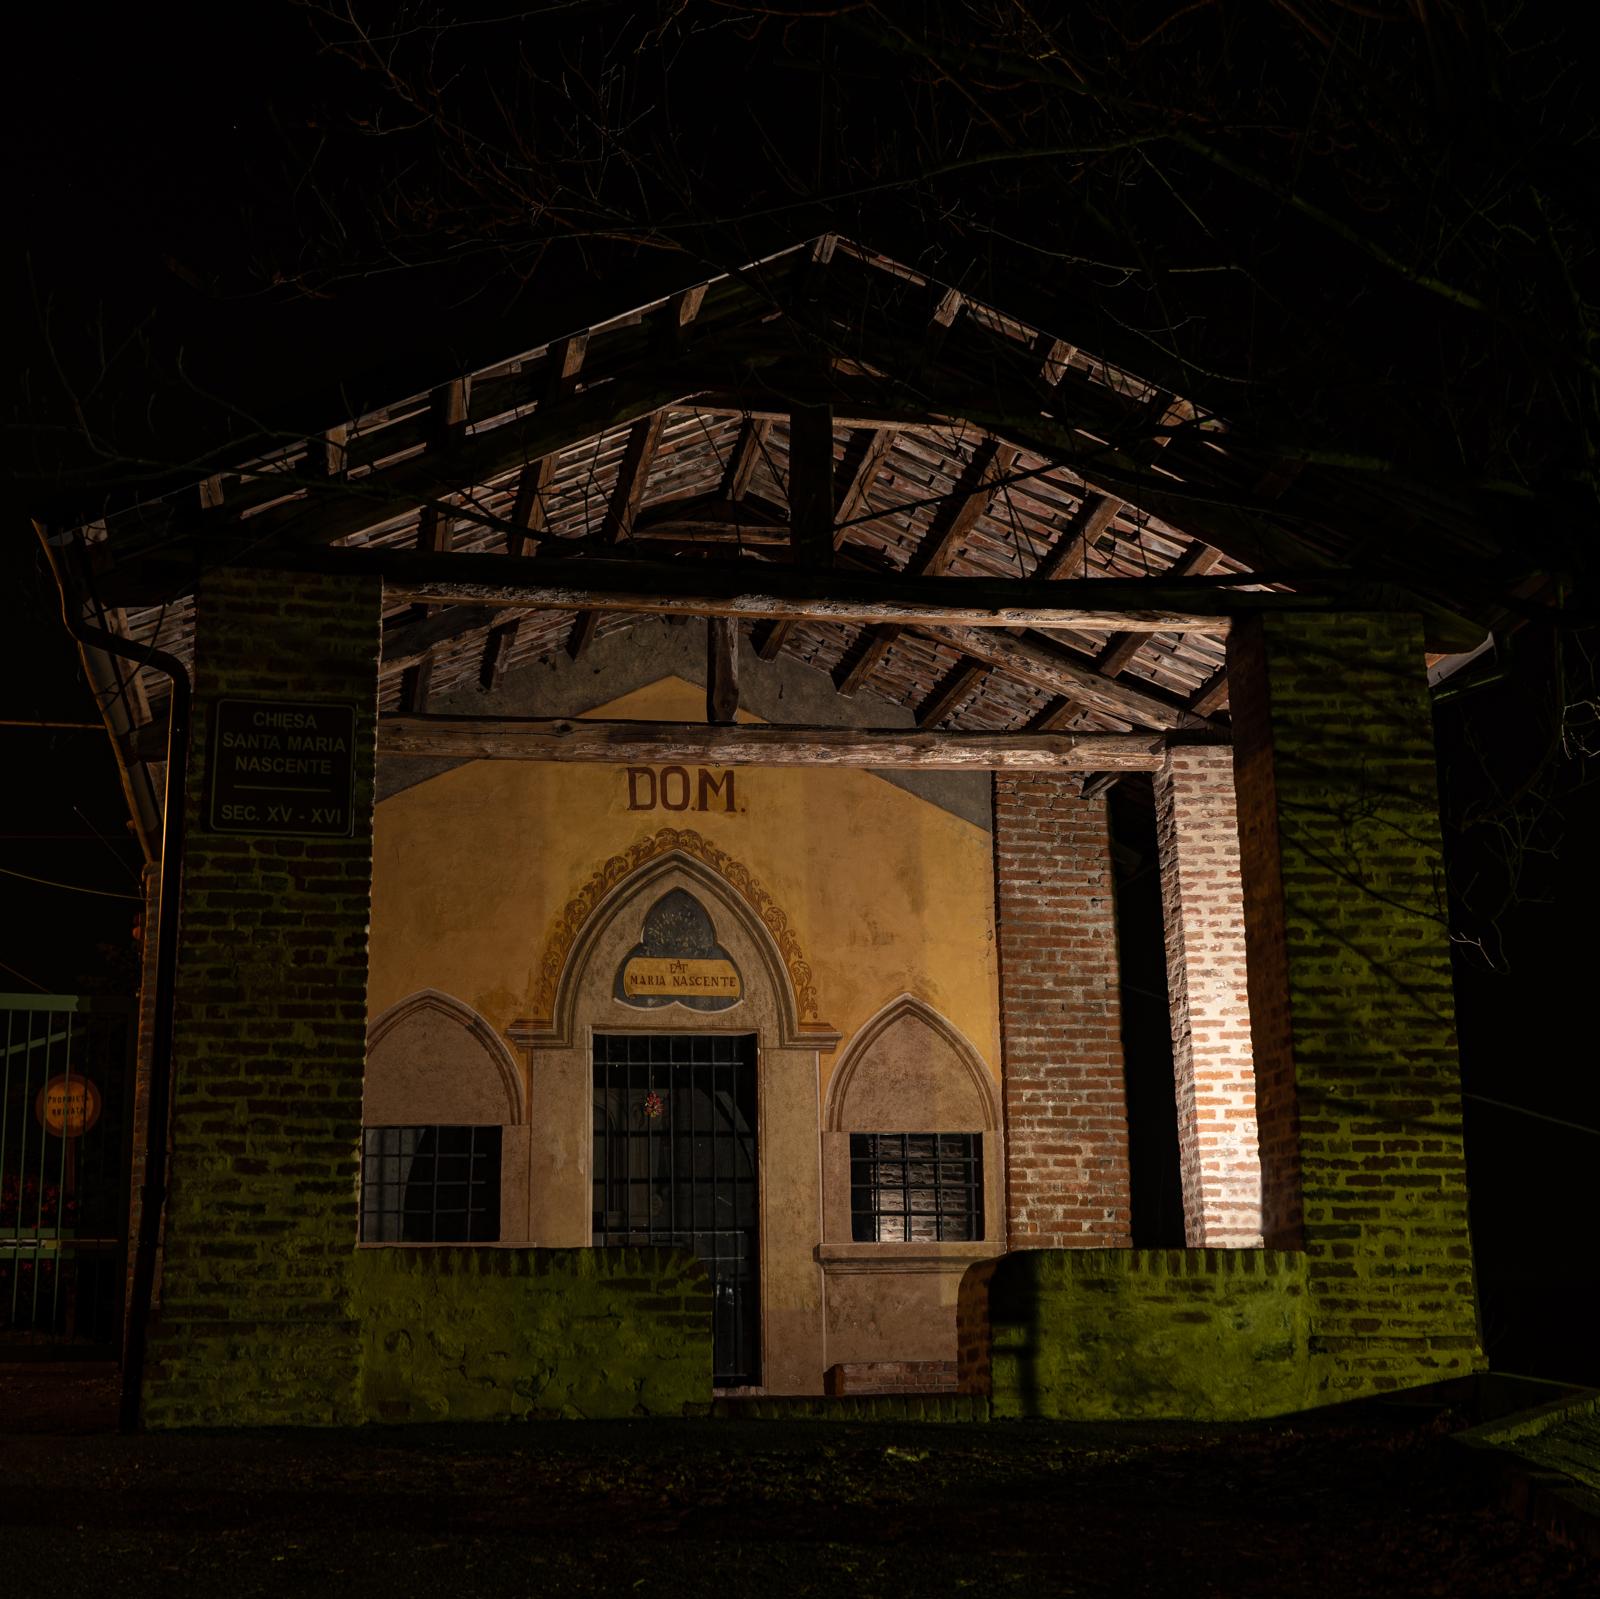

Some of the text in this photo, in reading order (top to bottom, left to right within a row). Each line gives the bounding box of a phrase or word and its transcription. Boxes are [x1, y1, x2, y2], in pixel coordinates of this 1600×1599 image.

[252, 711, 319, 729] CHIESA
[222, 732, 347, 752] SANTA MARIA
[234, 756, 334, 775] NASCENTE
[220, 804, 260, 822] SEC.
[266, 807, 293, 823] XV
[311, 808, 342, 825] XVI
[629, 975, 737, 988] MARIA NASCENTE
